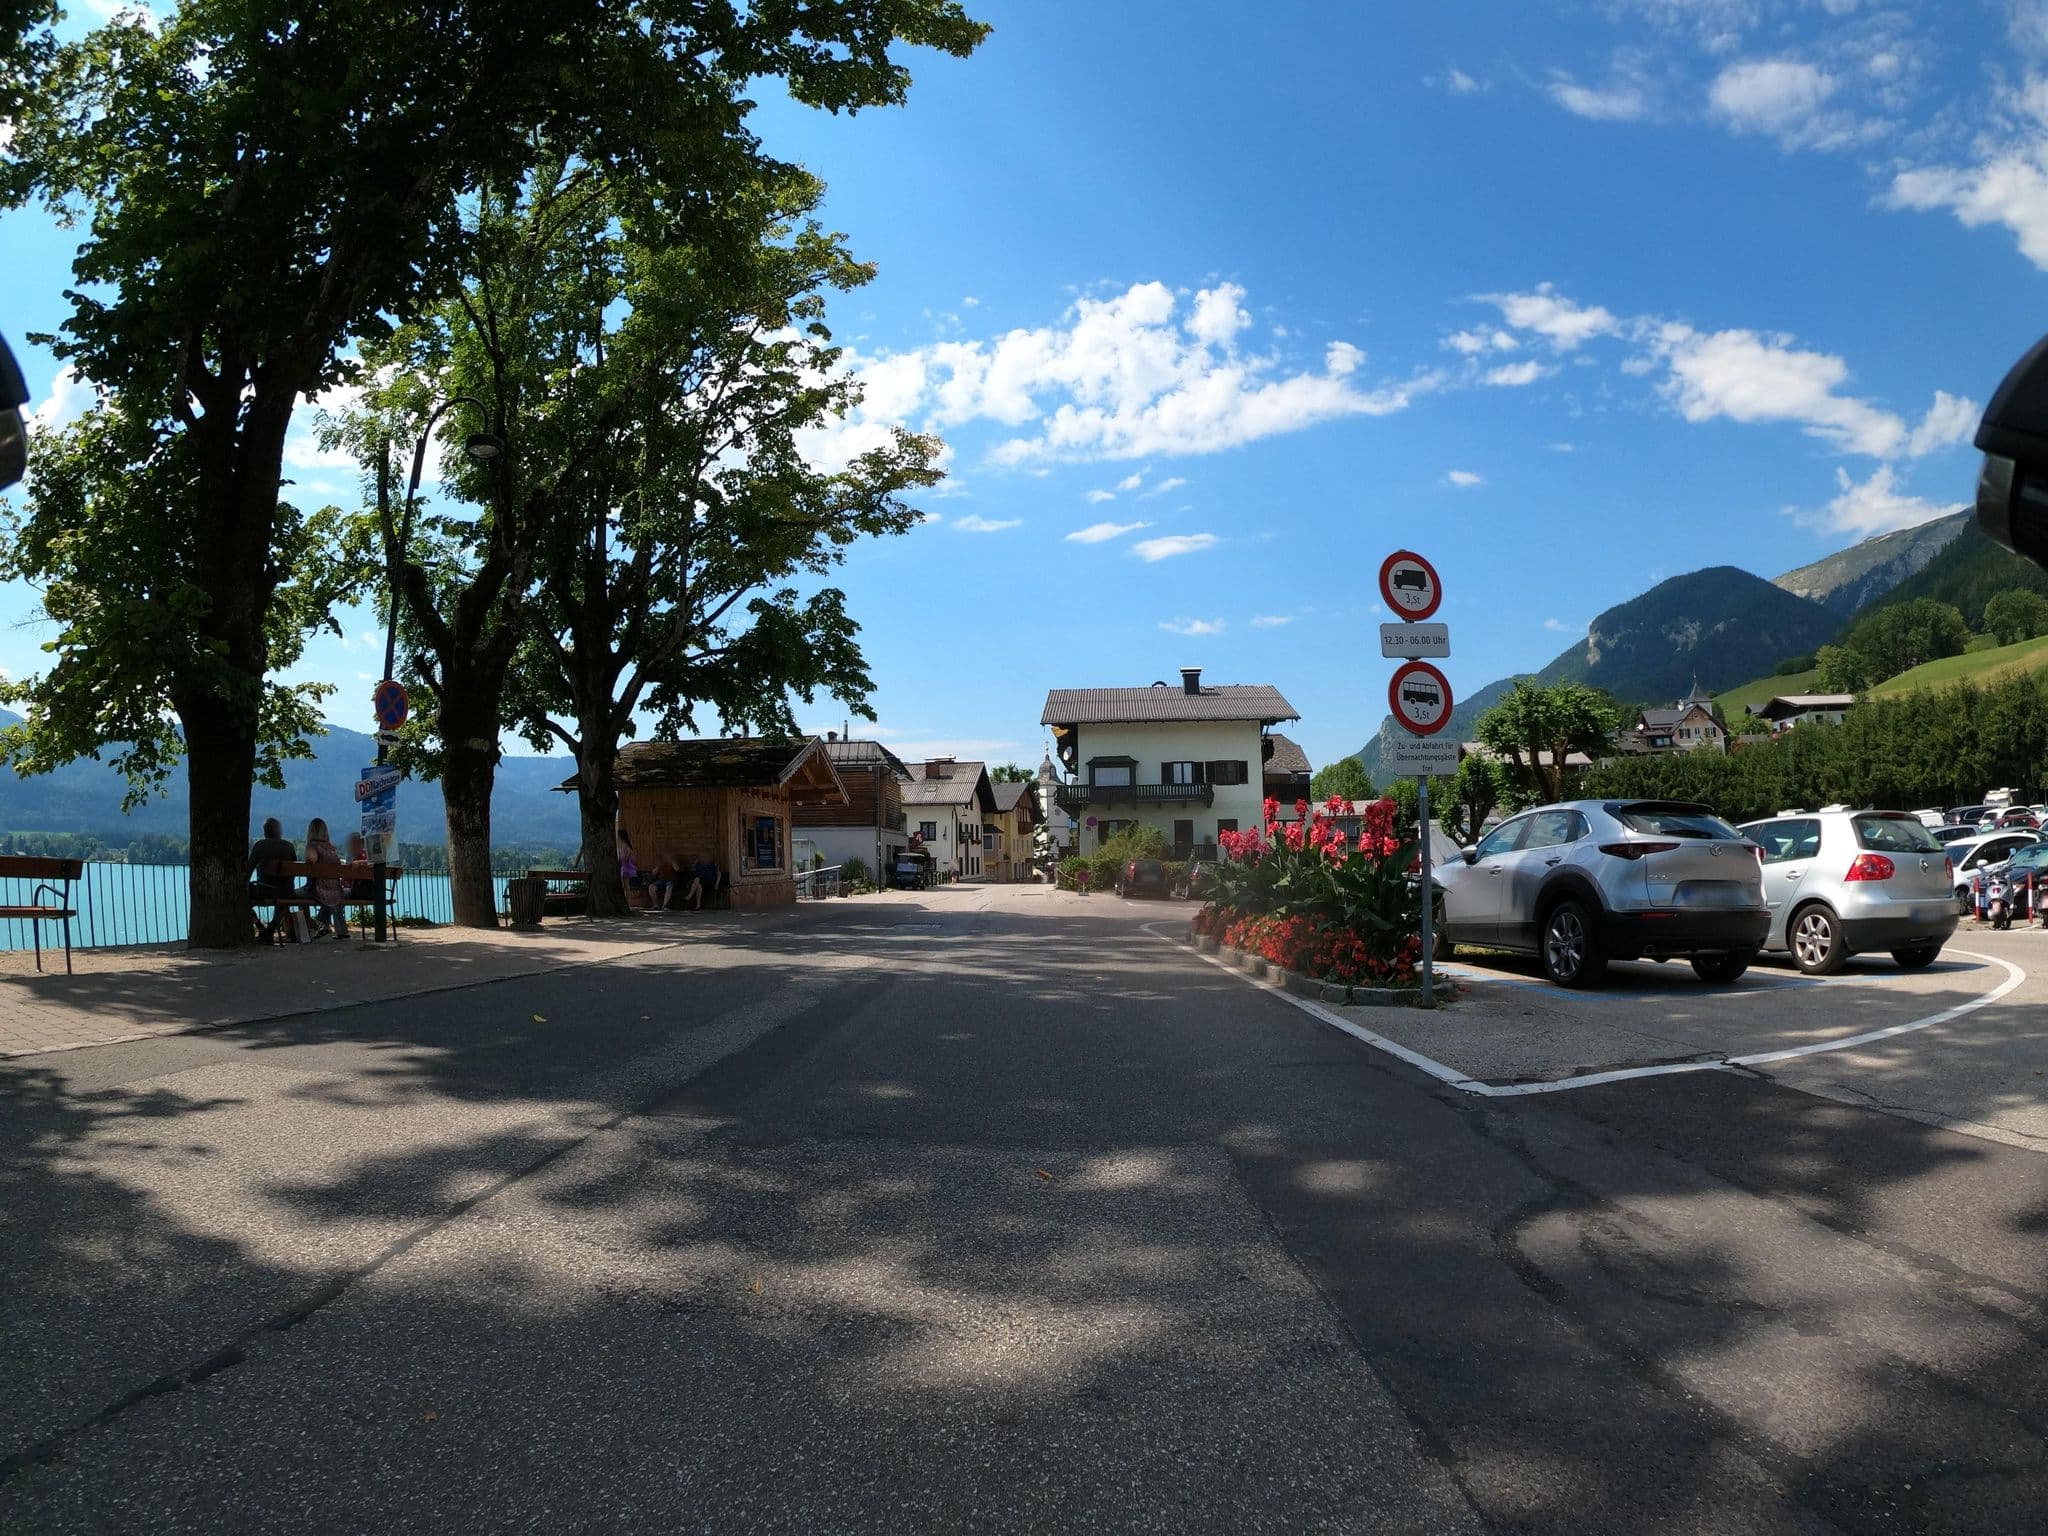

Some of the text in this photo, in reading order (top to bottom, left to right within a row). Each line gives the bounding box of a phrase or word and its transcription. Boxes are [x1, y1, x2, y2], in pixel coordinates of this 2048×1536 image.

[1405, 593, 1421, 605] 3,5t
[1384, 635, 1404, 645] 12.30
[1410, 635, 1431, 645] 06.00
[1433, 635, 1446, 645] Uhr
[1415, 707, 1430, 720] 3,5t
[1397, 742, 1454, 750] Zu- und Abfahrt für
[1396, 751, 1457, 762] Übernachtungsgäste
[1422, 763, 1433, 772] frei
